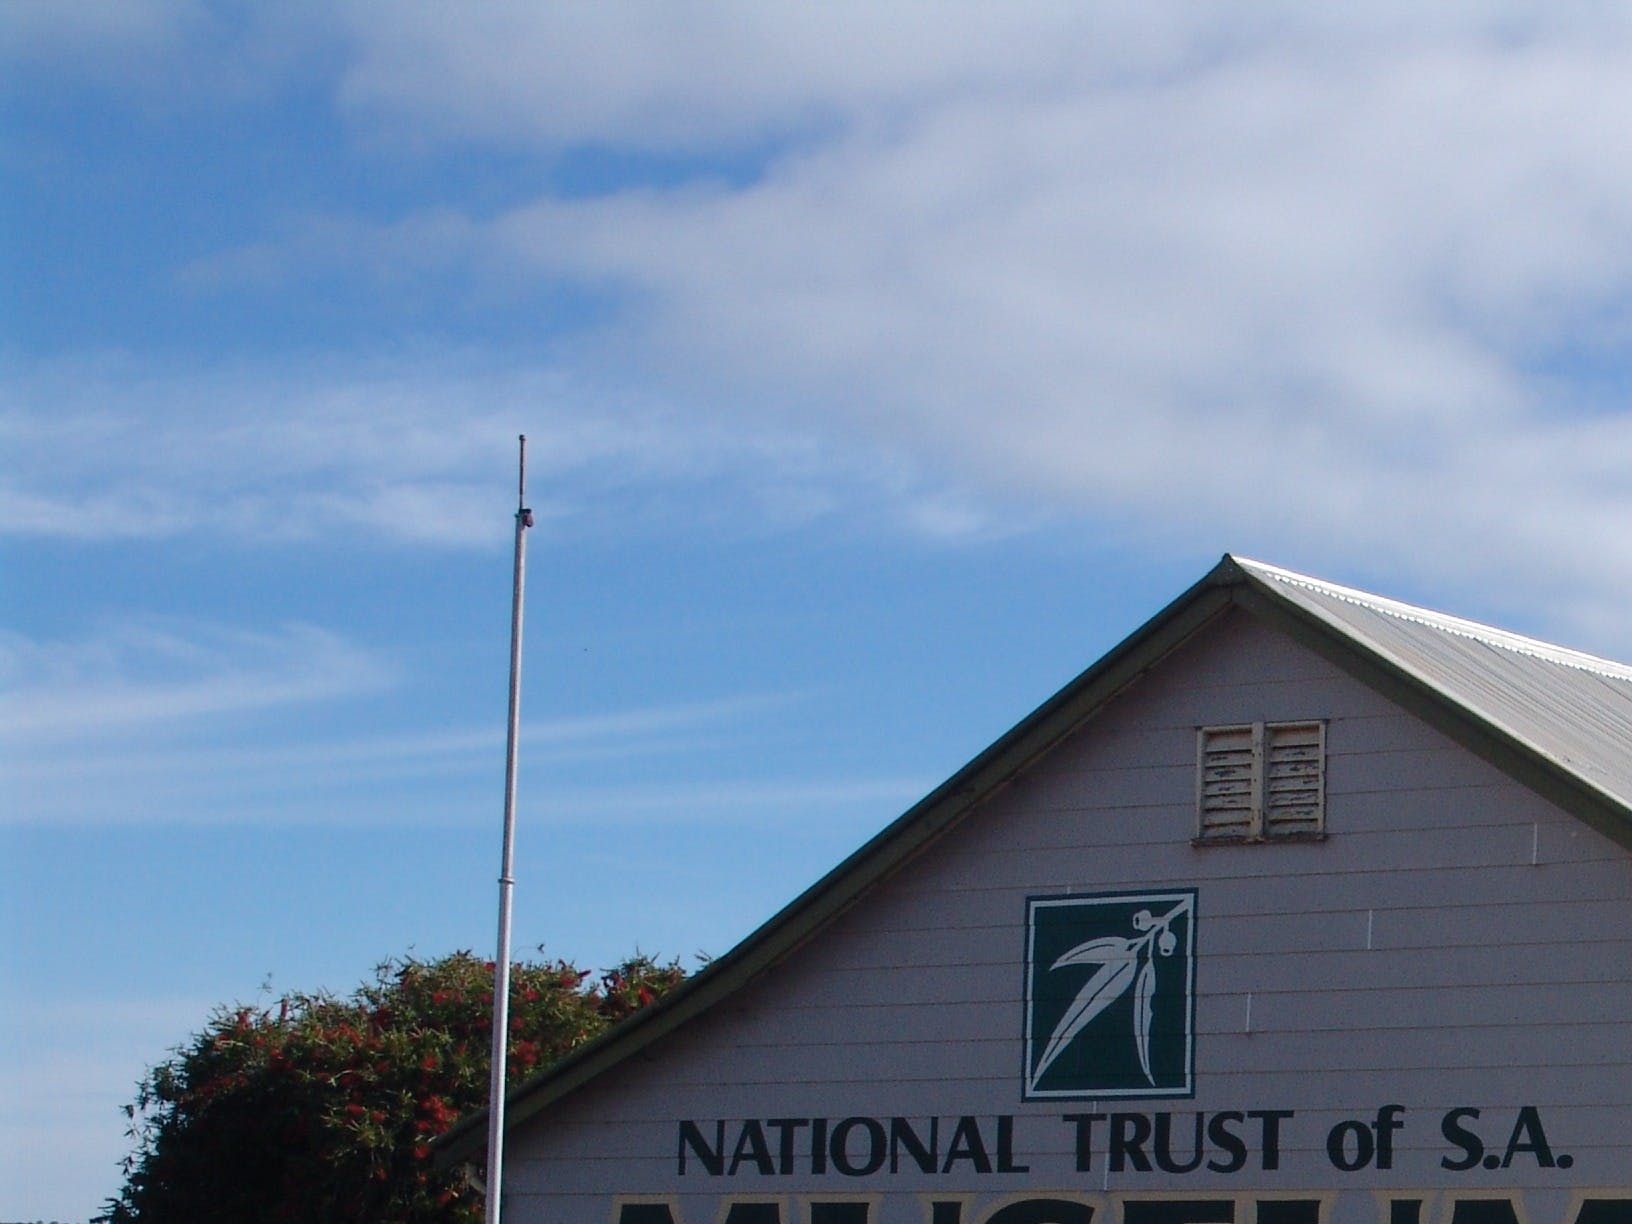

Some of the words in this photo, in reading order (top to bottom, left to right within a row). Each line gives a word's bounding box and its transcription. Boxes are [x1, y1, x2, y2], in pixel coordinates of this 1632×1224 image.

[678, 1116, 1030, 1176] NATIONAL
[1062, 1109, 1294, 1174] TRUST
[1326, 1104, 1404, 1171] of
[1440, 1106, 1574, 1171] S.A.
